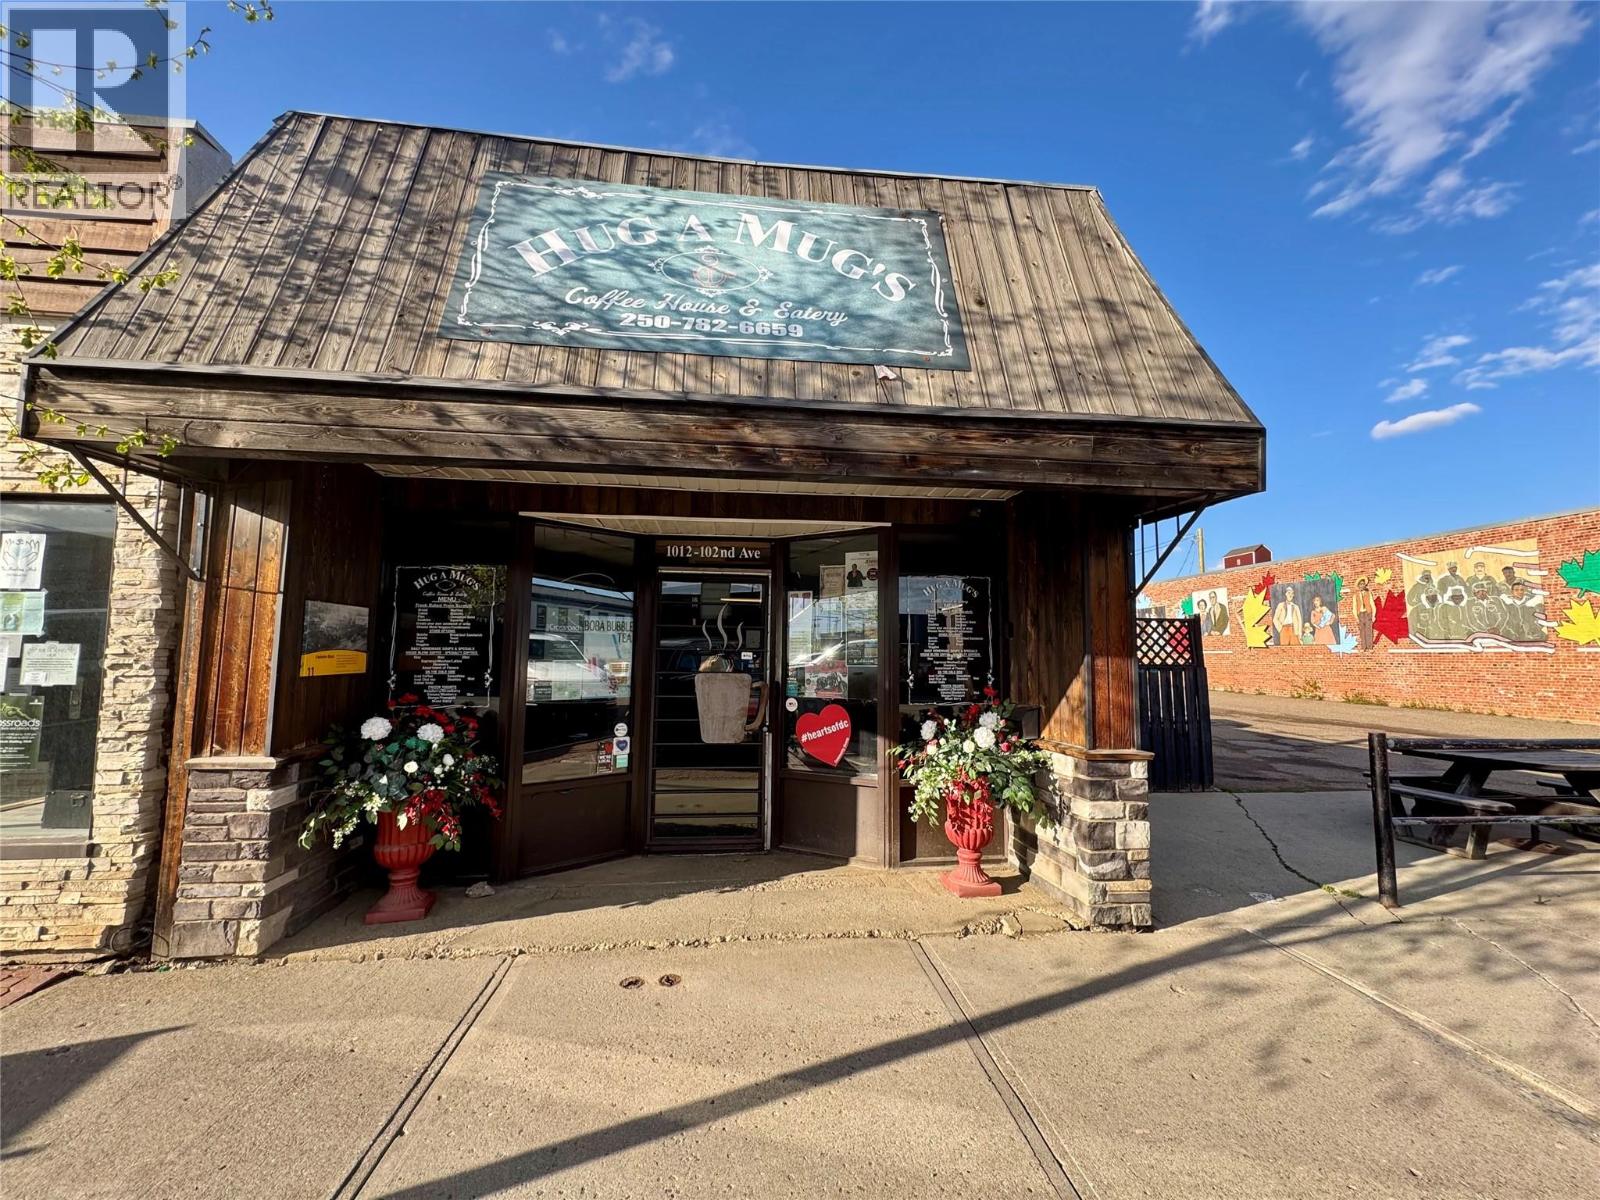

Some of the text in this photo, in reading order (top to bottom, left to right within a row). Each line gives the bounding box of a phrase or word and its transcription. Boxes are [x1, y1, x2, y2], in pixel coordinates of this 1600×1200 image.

[508, 212, 916, 302] HUG A MUG'S
[565, 286, 848, 327] Coffee House & Eatery
[619, 312, 804, 338] 250-782-6659
[666, 545, 761, 559] 1012-102nd Ave
[413, 572, 438, 590] HUG
[440, 571, 447, 579] A
[618, 632, 633, 643] TEA
[801, 719, 849, 743] #heartsofdc
